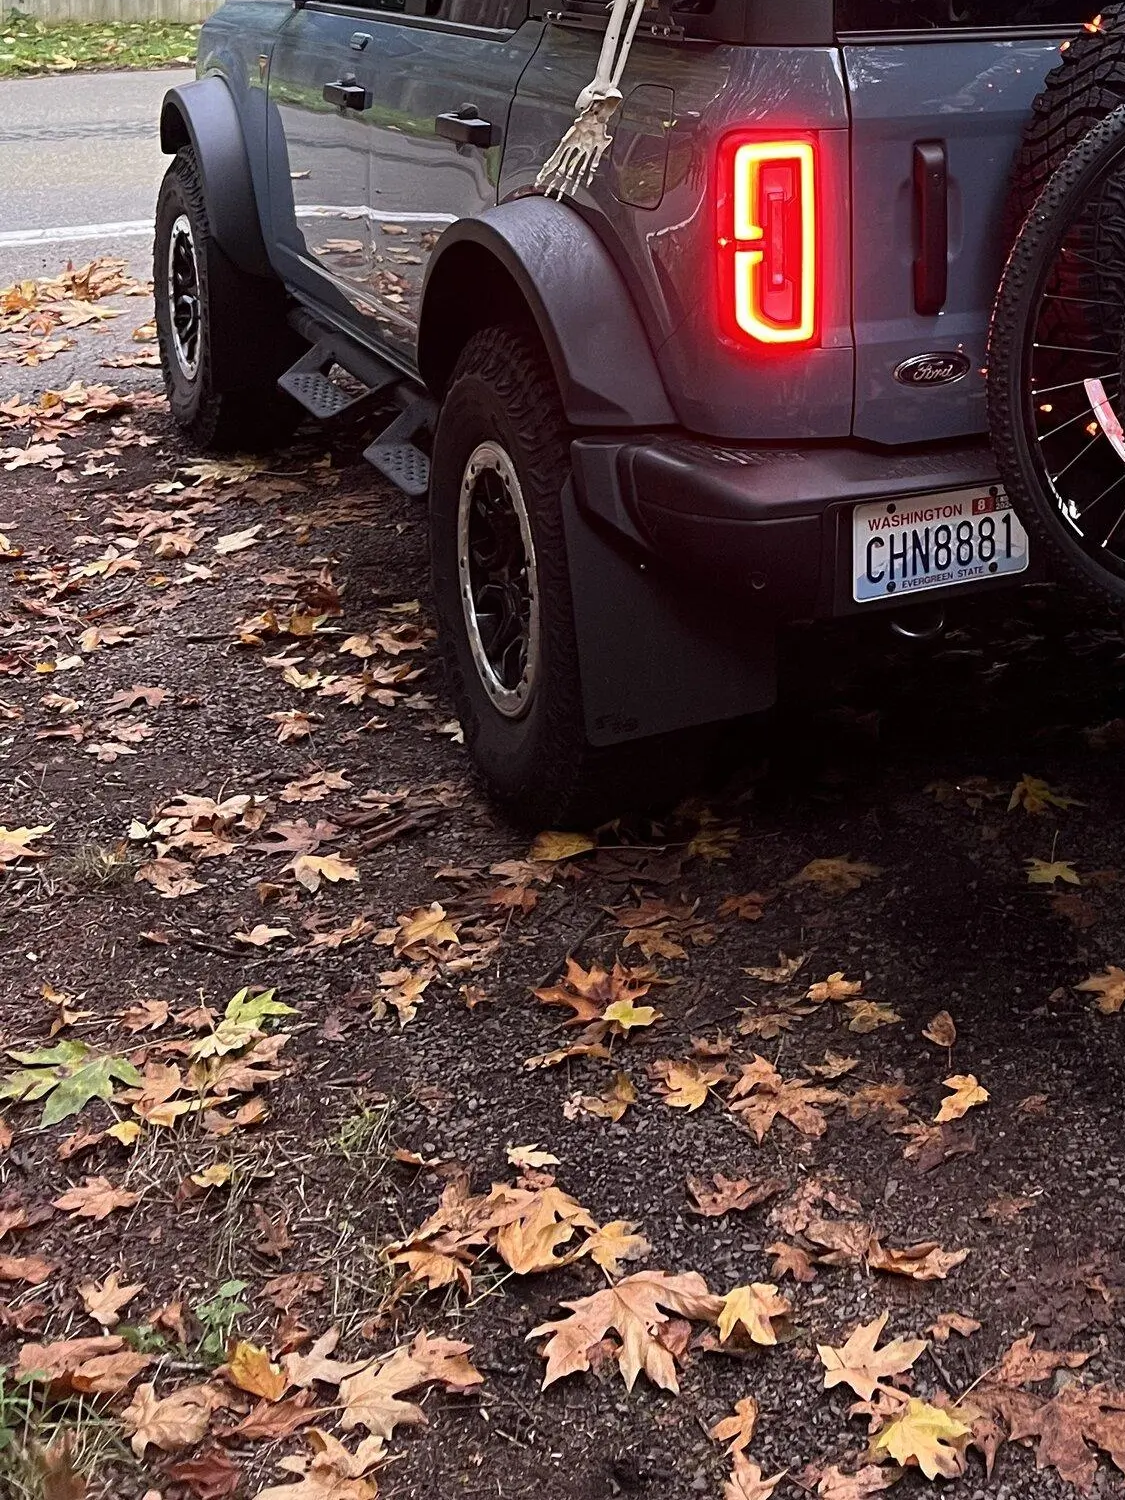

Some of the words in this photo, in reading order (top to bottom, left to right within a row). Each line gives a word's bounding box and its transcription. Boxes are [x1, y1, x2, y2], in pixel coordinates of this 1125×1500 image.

[913, 361, 954, 380] Ford
[977, 498, 986, 511] 8
[868, 503, 963, 531] WASHINGTON
[866, 513, 1011, 584] CHN8881
[902, 572, 954, 589] EVERGREEN
[958, 565, 984, 578] STATE
